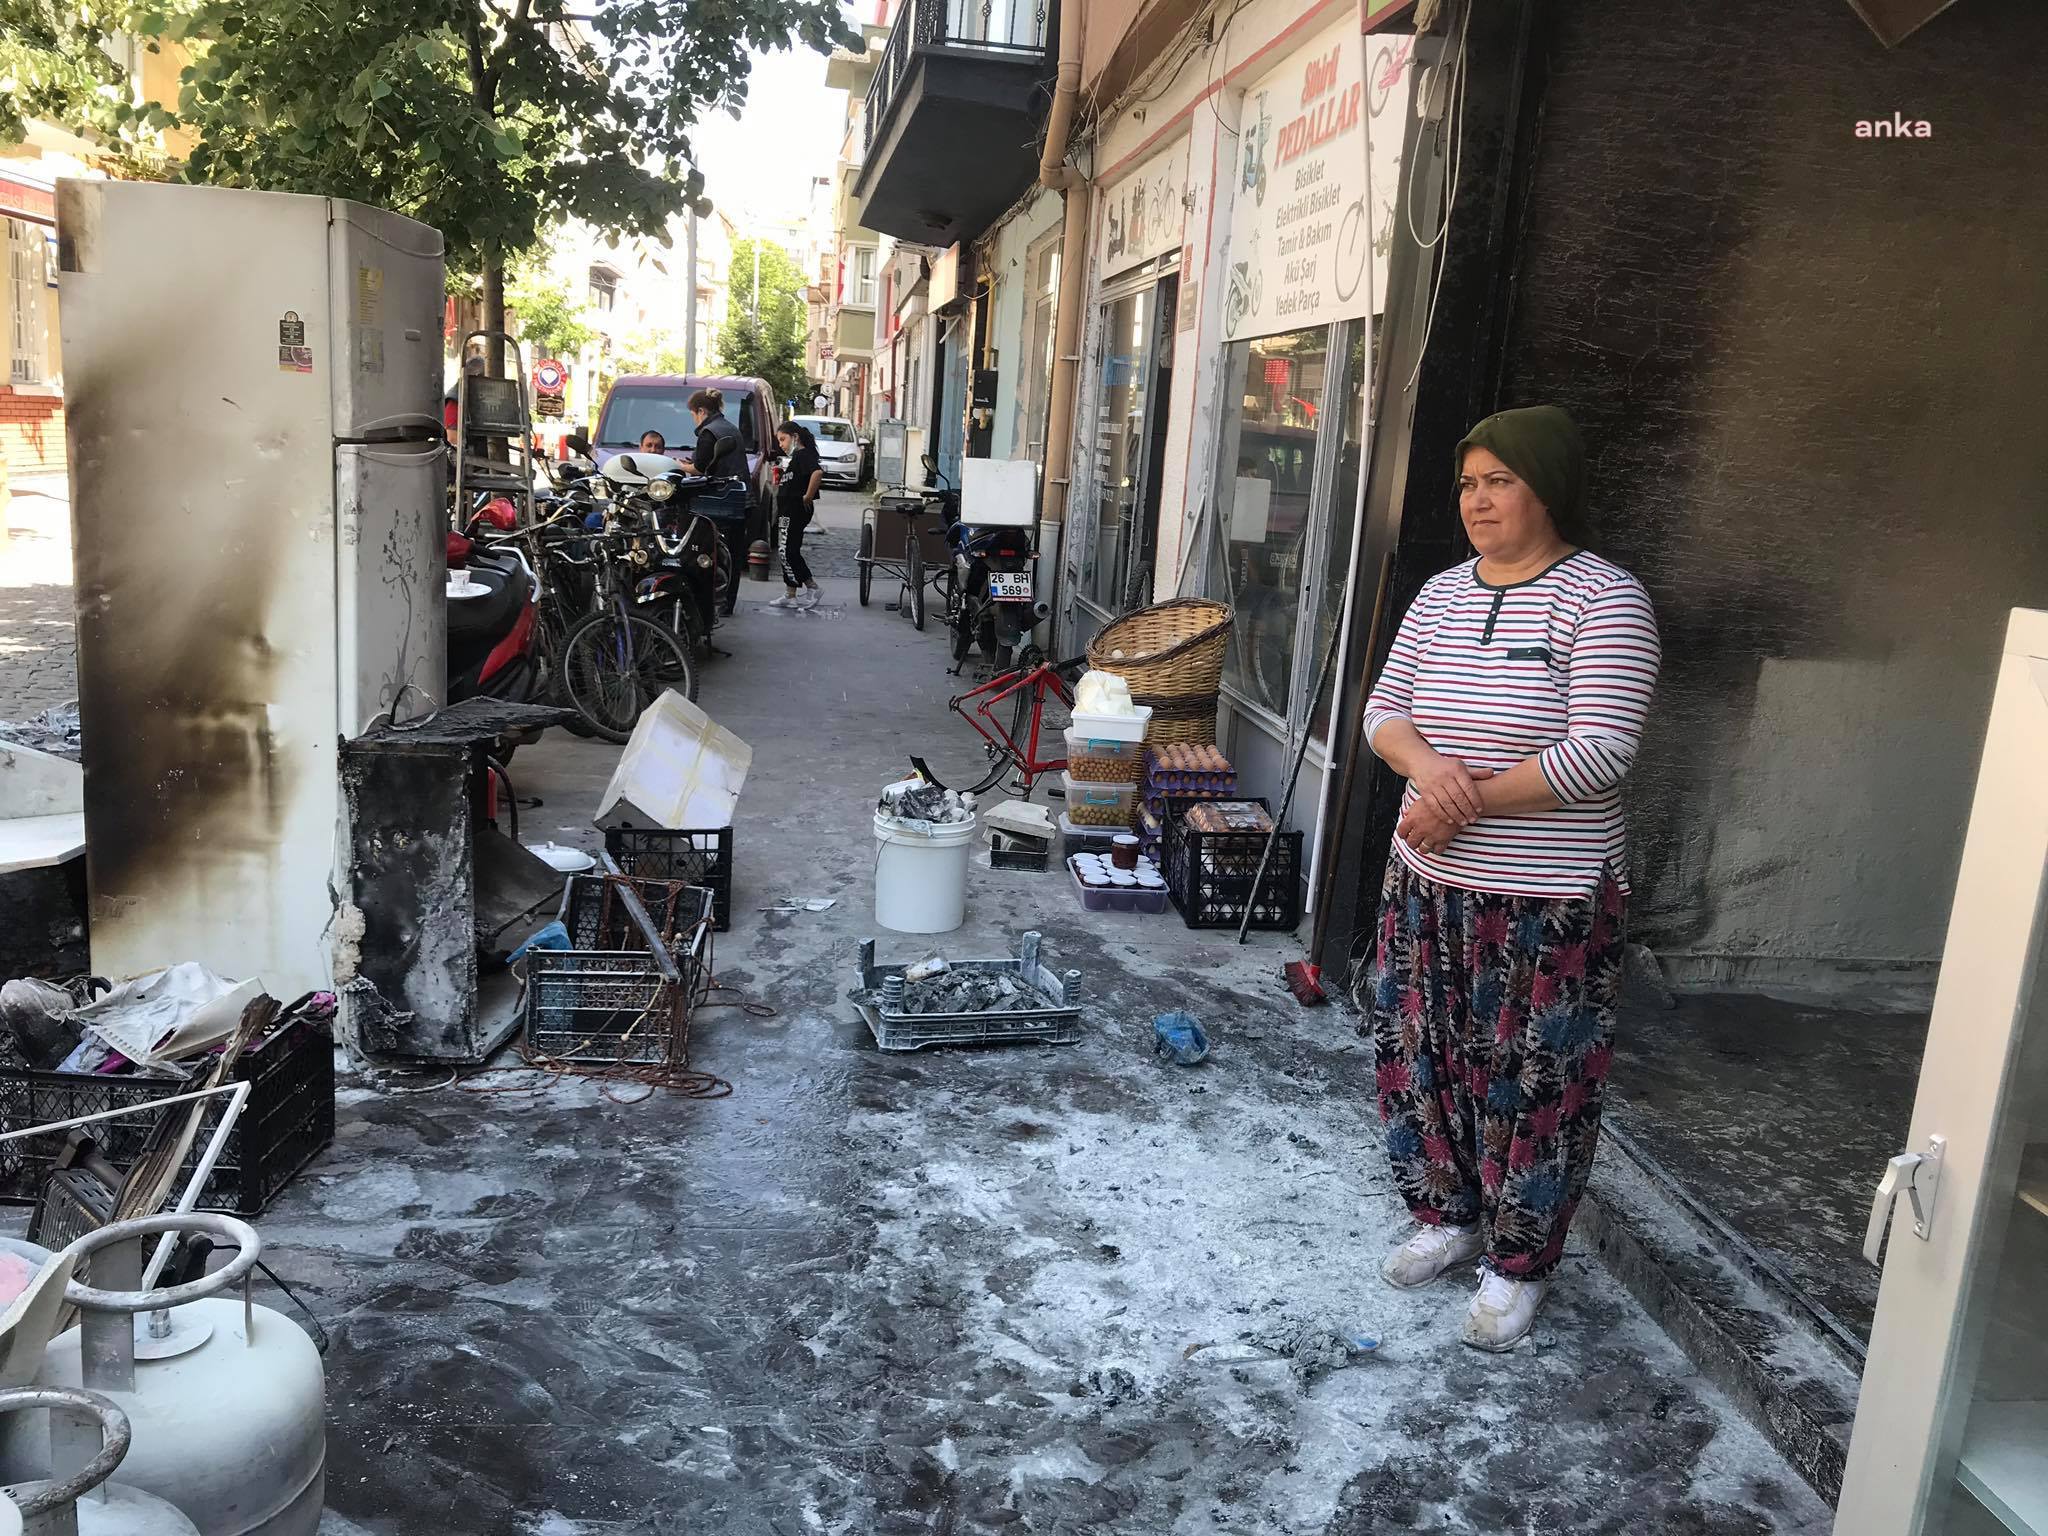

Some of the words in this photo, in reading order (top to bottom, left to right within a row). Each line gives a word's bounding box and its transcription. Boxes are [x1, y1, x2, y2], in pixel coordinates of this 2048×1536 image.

[1275, 81, 1360, 168] PEDALLAR
[1295, 160, 1325, 191] Bisiklet
[1276, 194, 1310, 229] Elektrikli
[1310, 184, 1341, 215] Bisiklet
[1278, 231, 1298, 256] Tamir
[1298, 227, 1305, 250] &
[1305, 220, 1332, 247] Bakım
[1284, 260, 1300, 285] Akü
[1300, 253, 1318, 286] Şarj
[1276, 290, 1298, 316] Yedek
[1298, 289, 1320, 315] Parça
[991, 574, 1005, 583] 26
[1013, 573, 1029, 583] BH
[1002, 585, 1022, 595] 569
